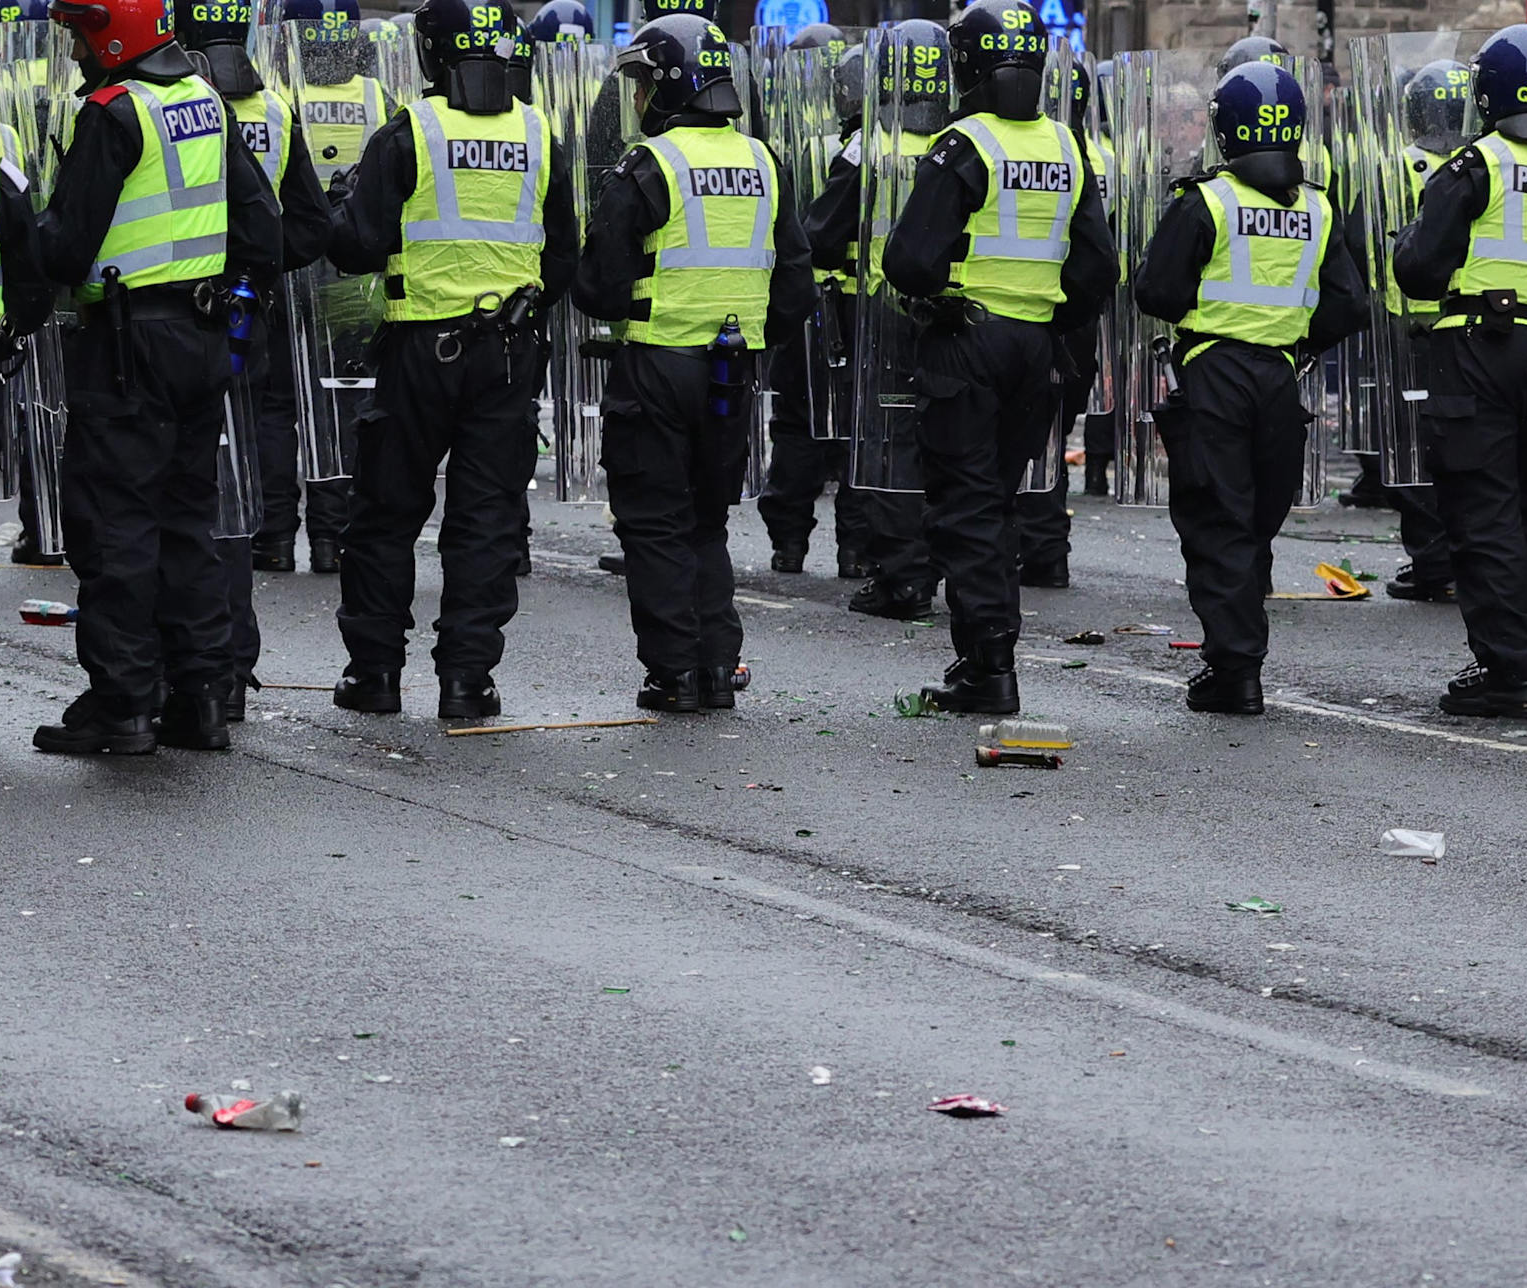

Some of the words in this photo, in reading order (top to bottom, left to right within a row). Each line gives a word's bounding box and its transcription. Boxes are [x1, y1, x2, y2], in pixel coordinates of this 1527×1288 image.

[0, 6, 22, 22] SP
[323, 12, 348, 29] SP
[473, 6, 502, 28] SP
[1001, 10, 1033, 29] SP
[305, 26, 358, 42] Q1550
[455, 30, 515, 50] G32
[980, 34, 1046, 53] G3234
[913, 46, 941, 65] SP
[168, 100, 222, 141] POLICE
[1258, 105, 1289, 126] SP
[1236, 124, 1302, 142] Q1108
[451, 141, 526, 172] POLICE
[694, 169, 762, 197] POLICE
[1008, 163, 1070, 192] POLICE
[1241, 208, 1310, 241] POLICE
